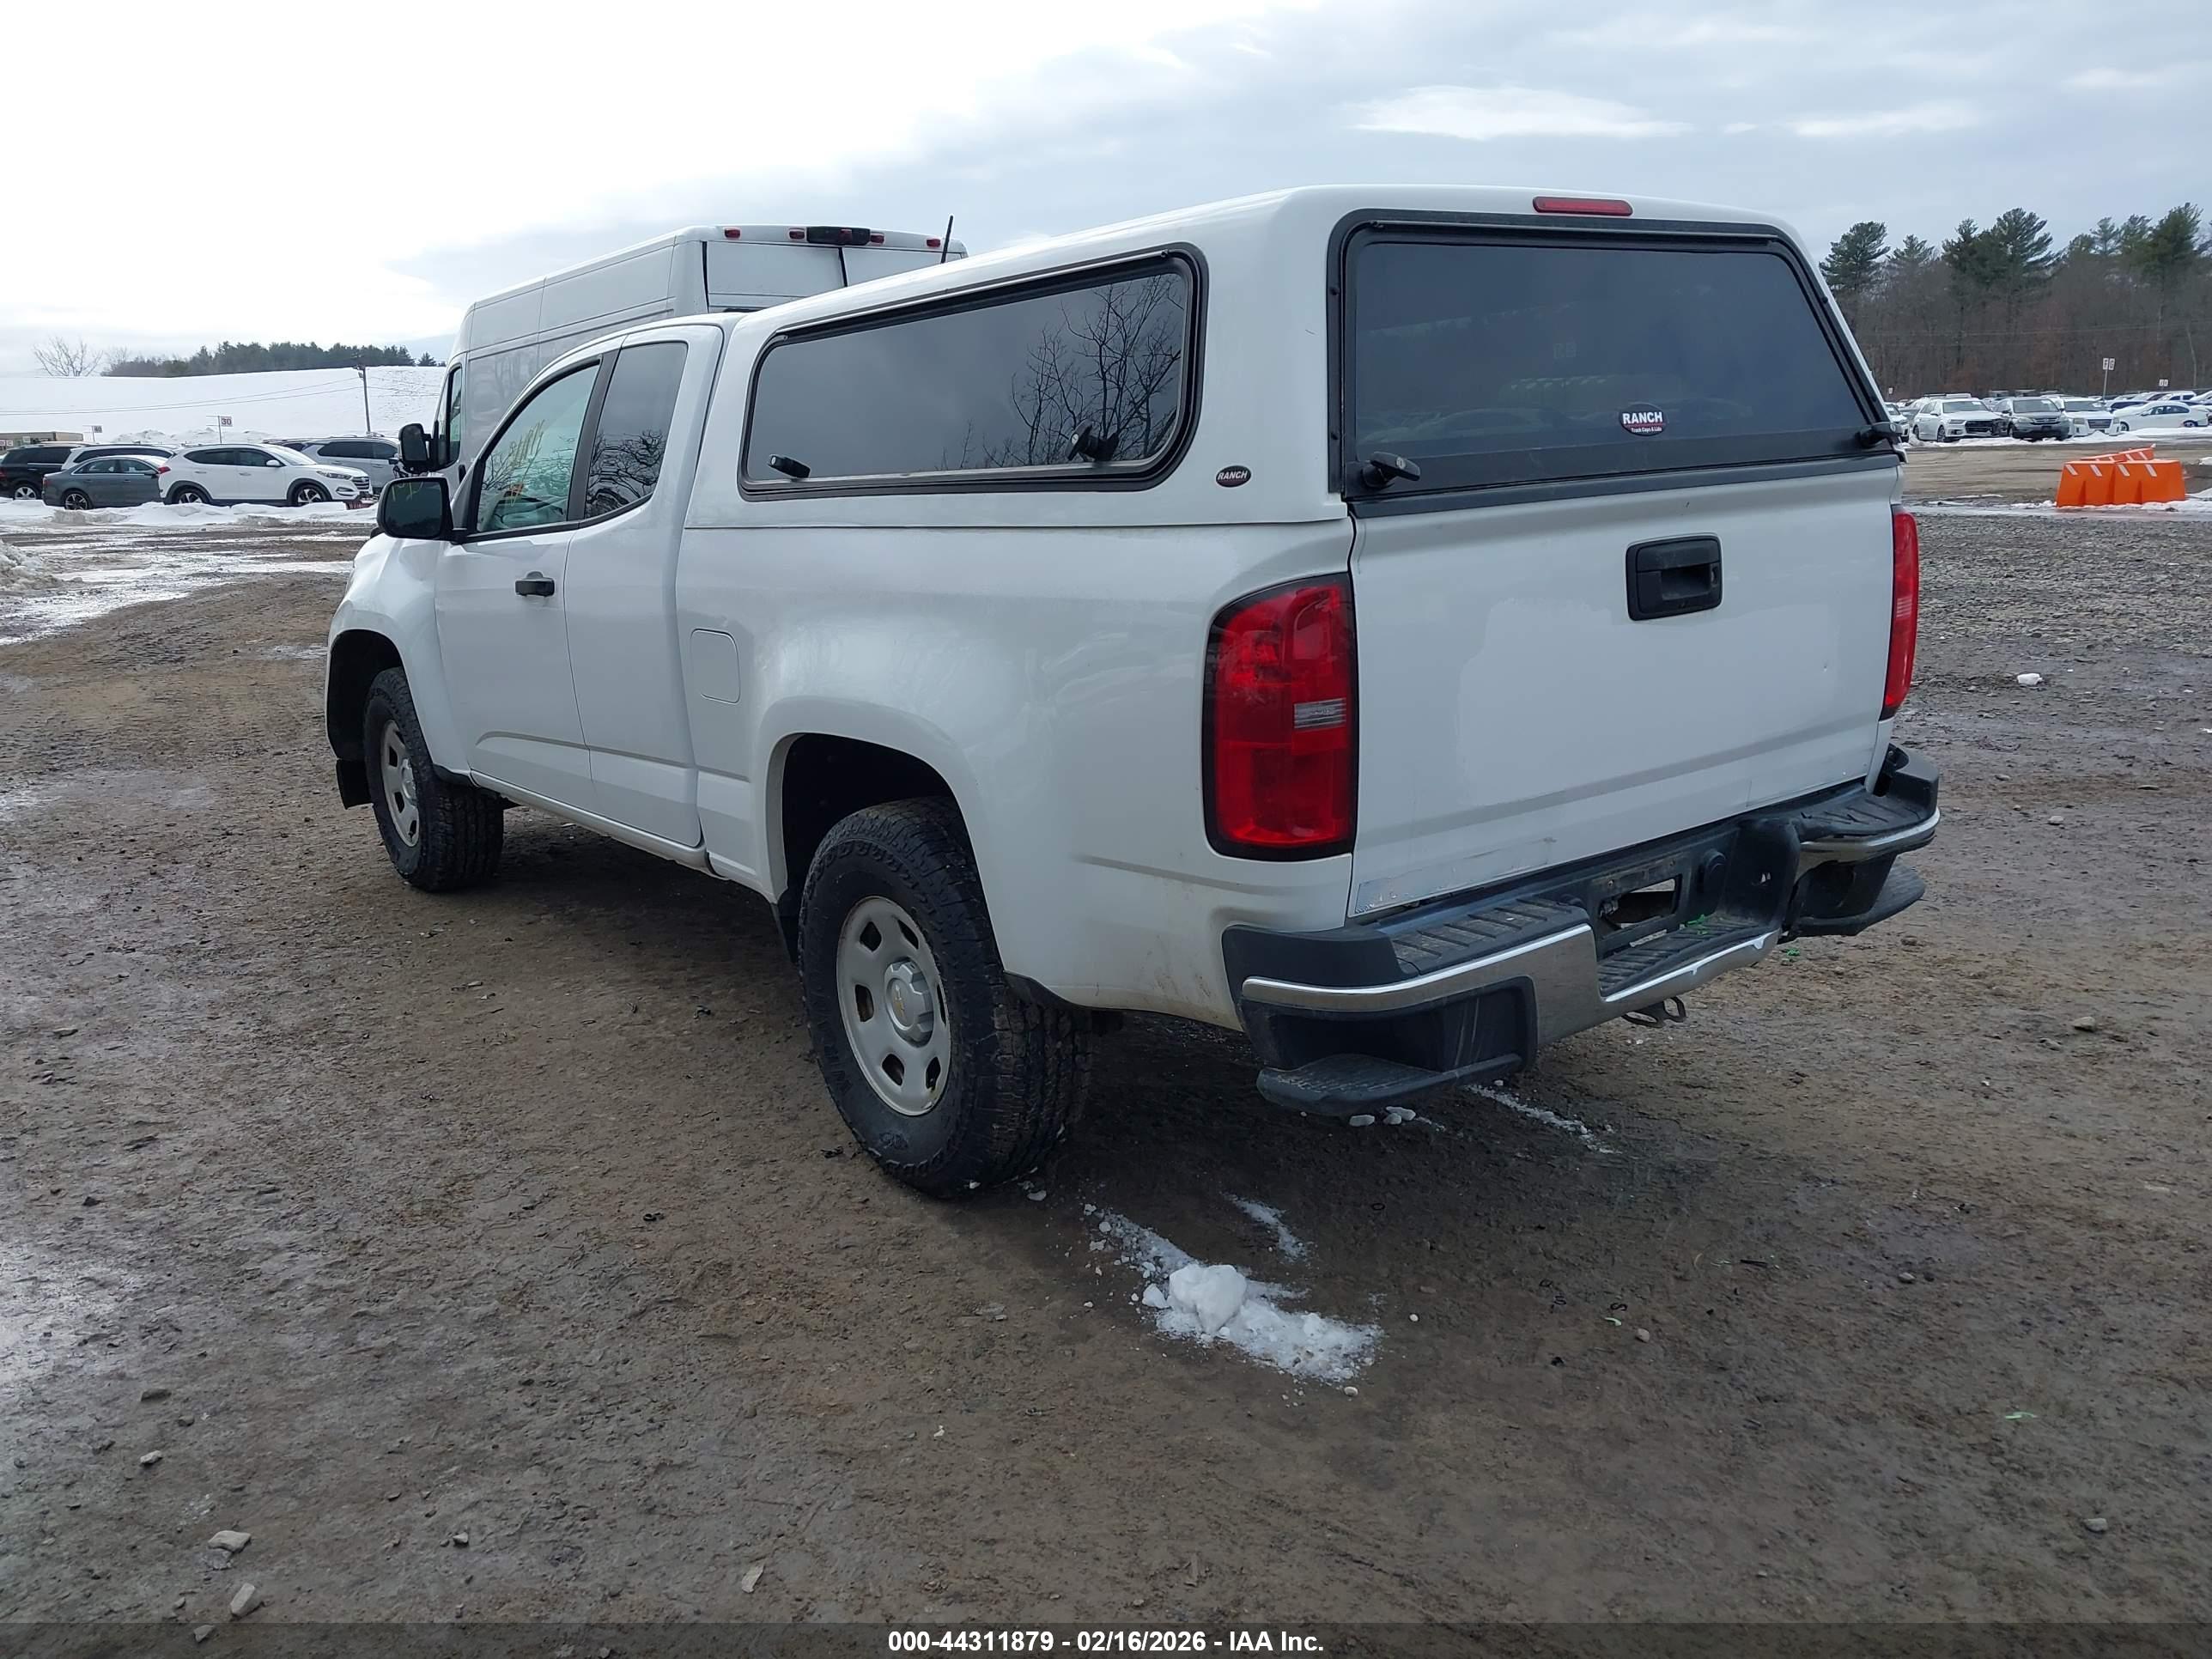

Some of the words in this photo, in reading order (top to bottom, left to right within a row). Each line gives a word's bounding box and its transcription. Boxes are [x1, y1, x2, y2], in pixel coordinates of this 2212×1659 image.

[221, 417, 232, 426] 30
[1622, 412, 1662, 424] RANCH
[1218, 471, 1248, 480] RANCH
